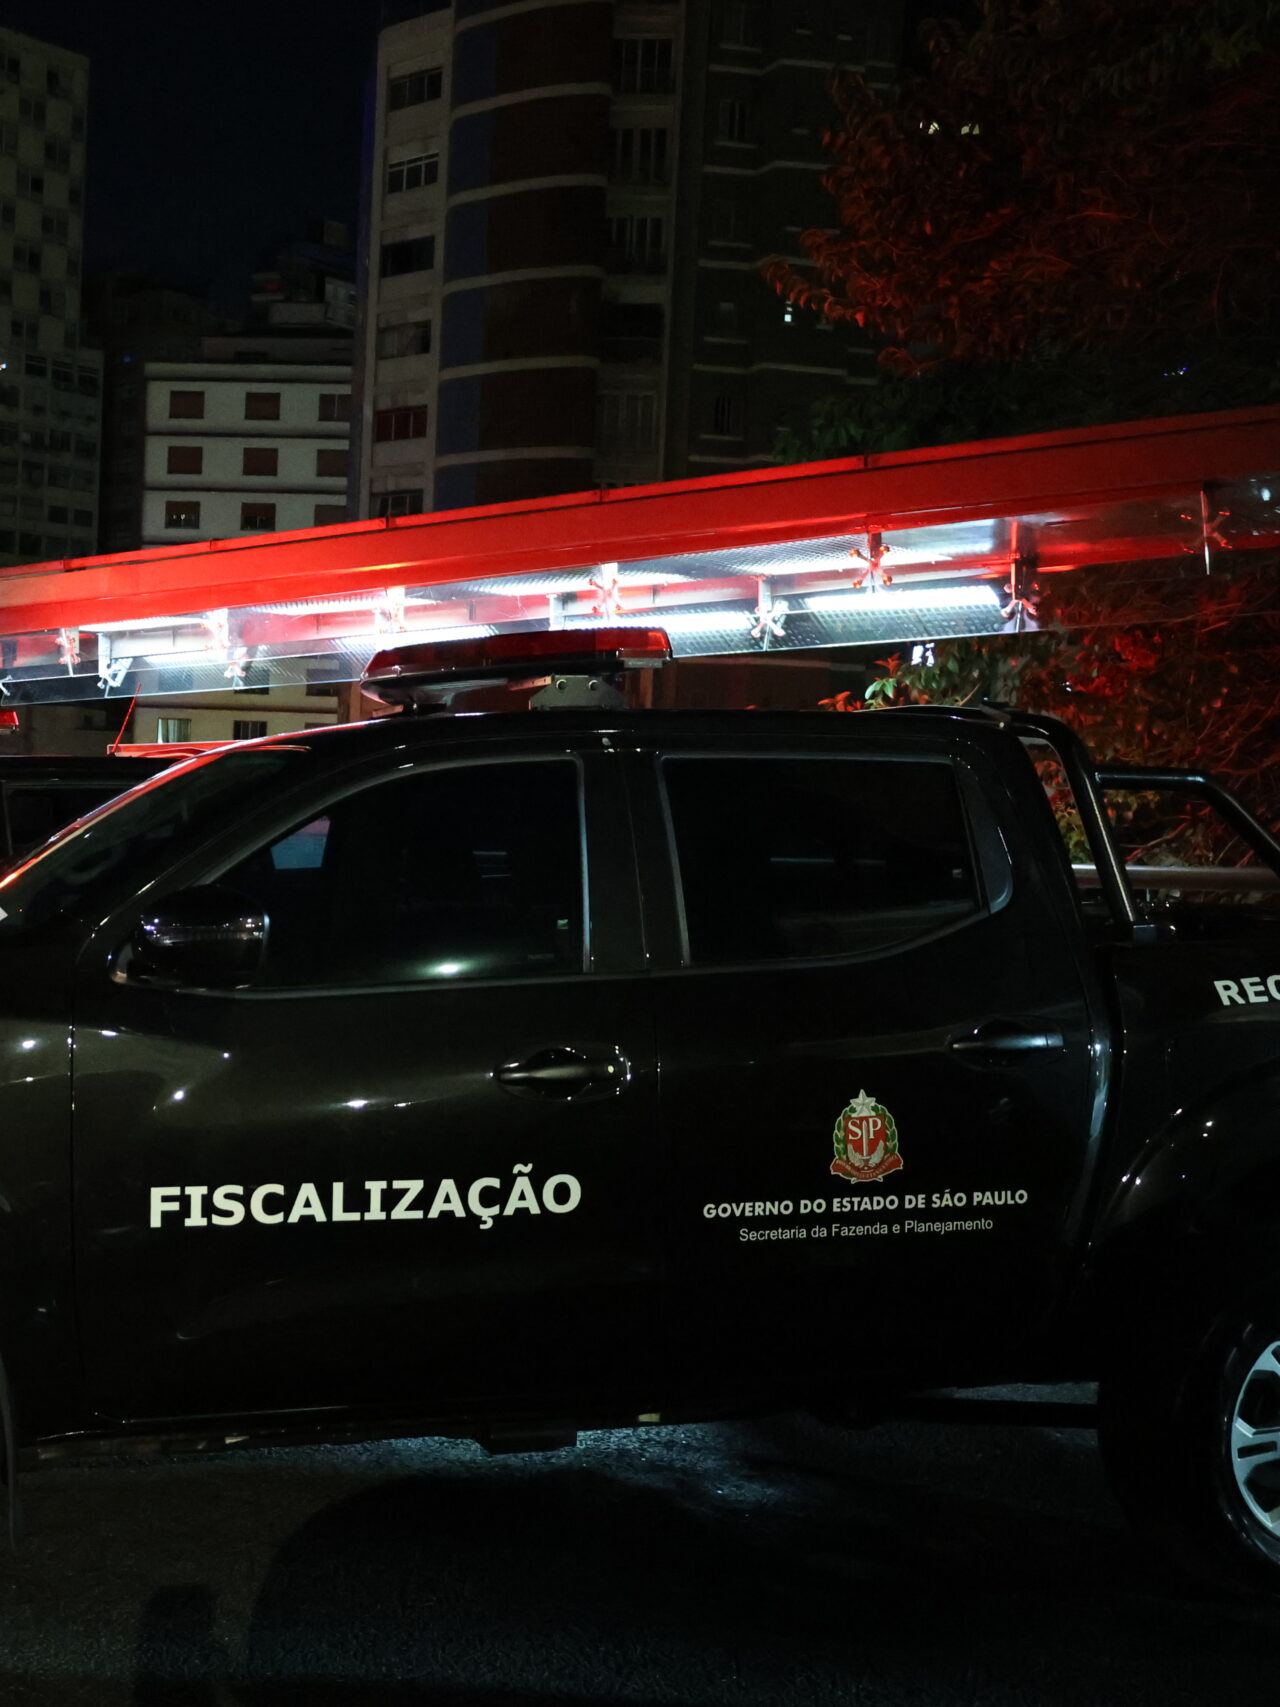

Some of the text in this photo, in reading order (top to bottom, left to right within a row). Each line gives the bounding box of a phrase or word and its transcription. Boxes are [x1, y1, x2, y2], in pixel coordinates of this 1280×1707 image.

[847, 1118, 882, 1140] SP
[150, 1163, 582, 1229] FISCALIZAÇÃO
[703, 1188, 1028, 1219] GOVERNO DO ESTADO DE SÃO PAULO
[739, 1218, 993, 1242] Secretaria da Fazenda e Planejamento
